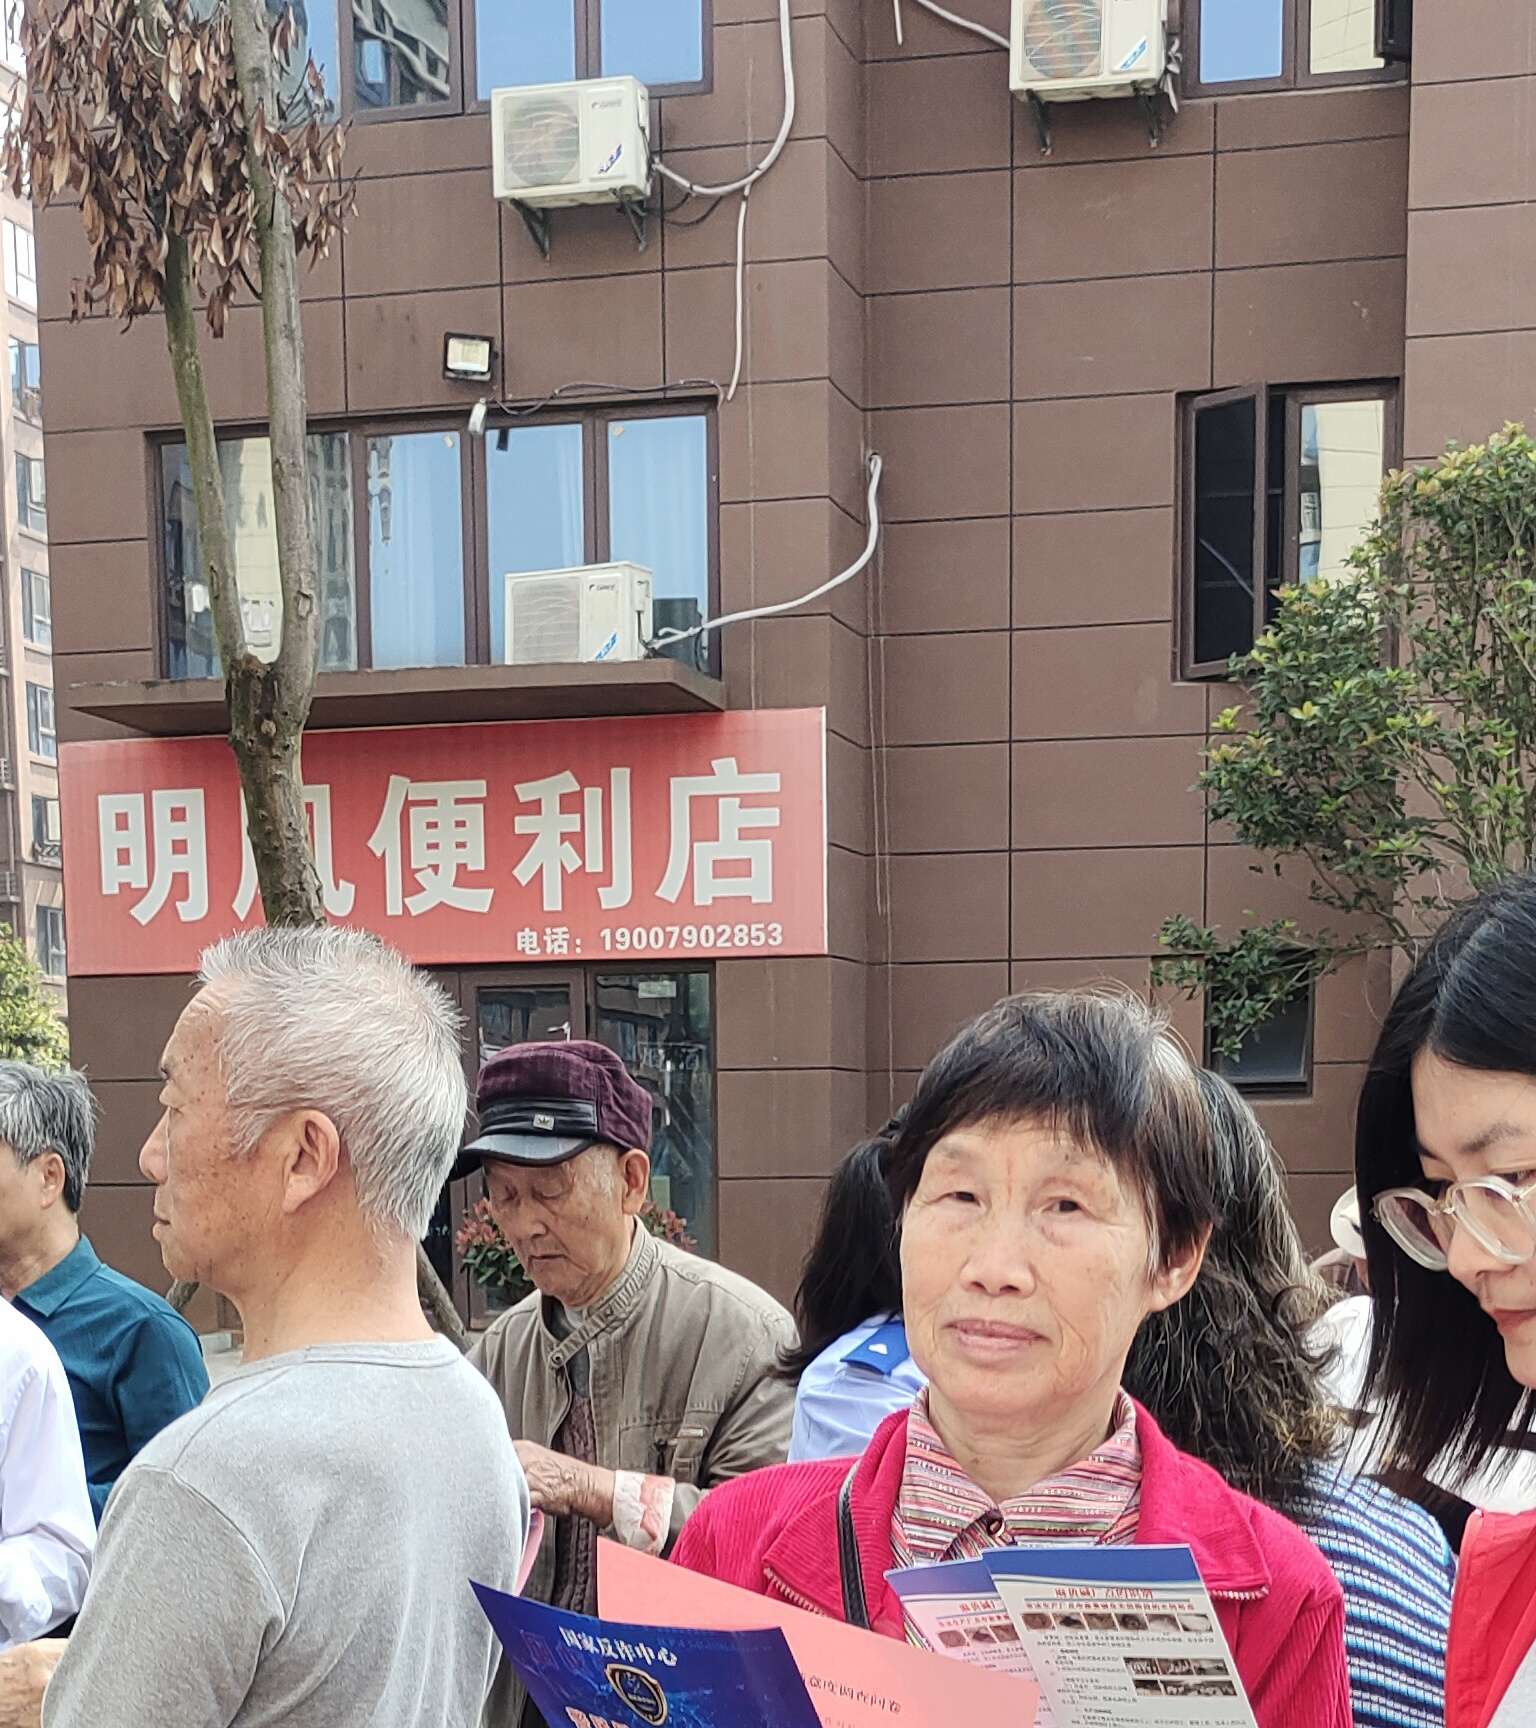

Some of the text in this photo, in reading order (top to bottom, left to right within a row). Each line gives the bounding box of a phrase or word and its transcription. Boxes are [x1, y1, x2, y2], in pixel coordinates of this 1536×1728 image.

[559, 1626, 678, 1667] 国家反诈中心
